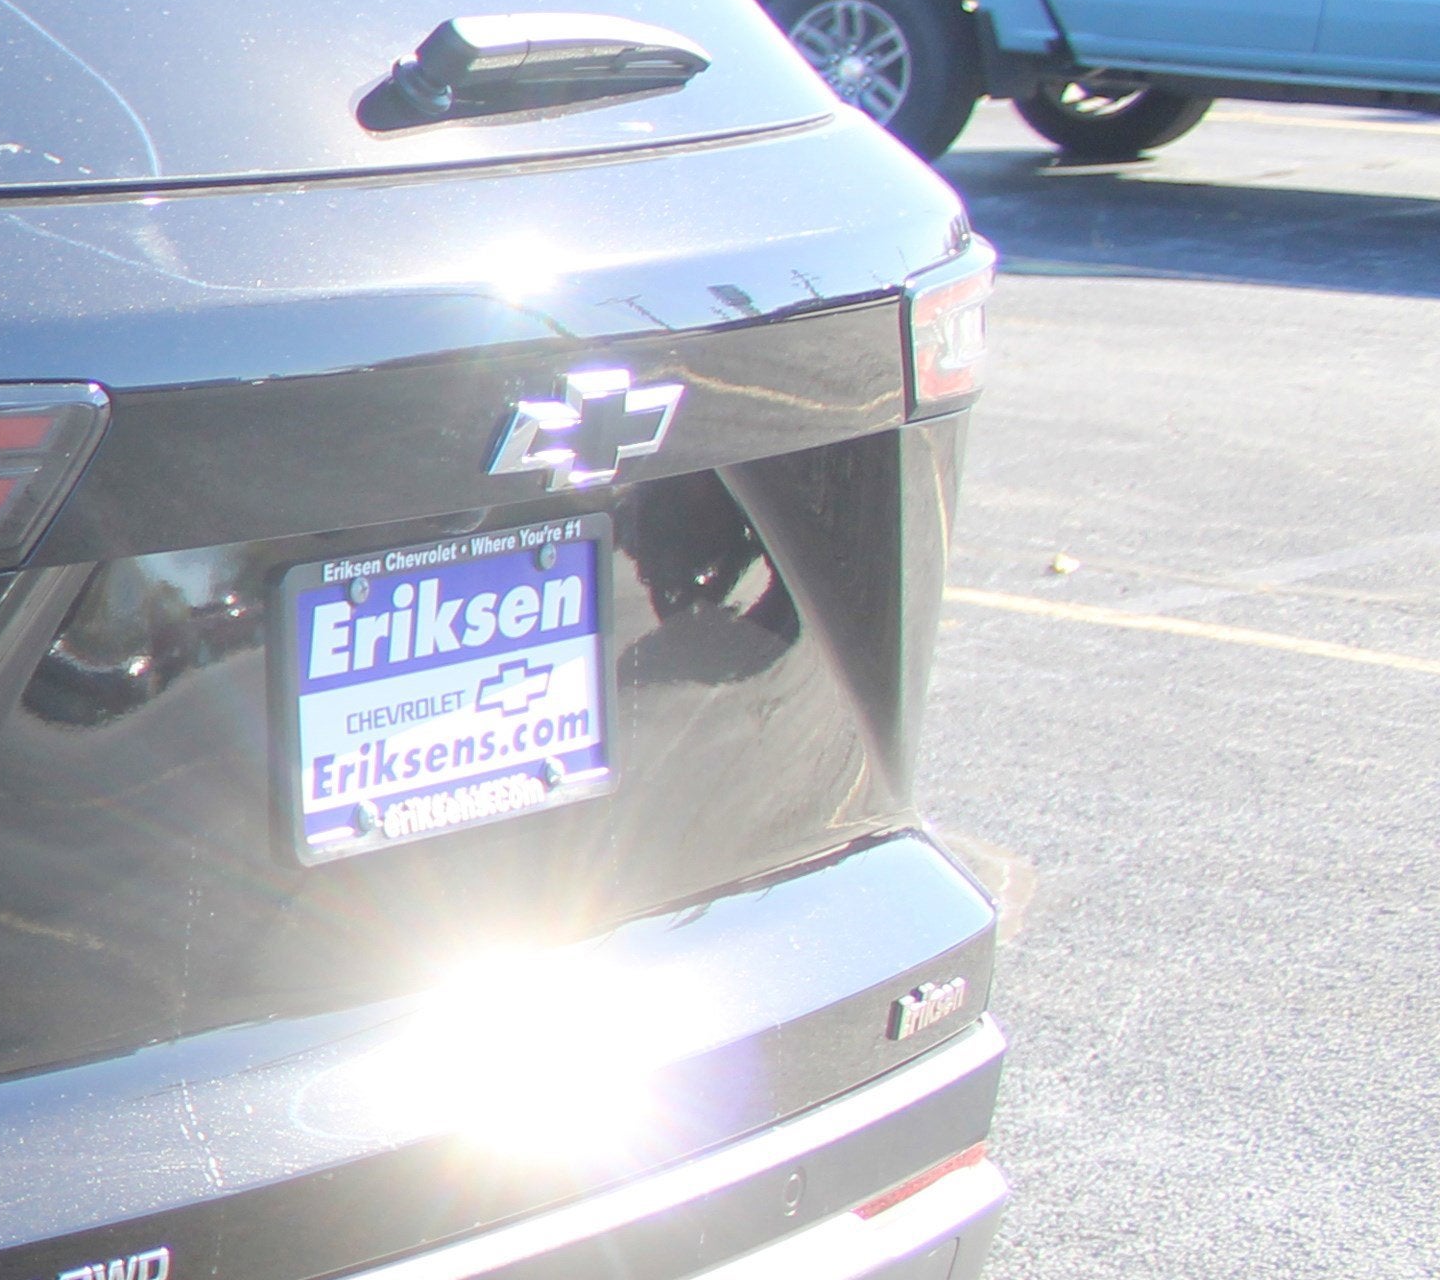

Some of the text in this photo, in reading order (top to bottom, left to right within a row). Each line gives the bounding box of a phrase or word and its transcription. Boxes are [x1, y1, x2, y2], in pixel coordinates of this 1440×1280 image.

[322, 519, 582, 583] Eriksen Chevrolet Where You're #1
[308, 574, 583, 680] Eriksen
[346, 689, 466, 735] CHEVROLET
[311, 707, 590, 801] Eriksens.com
